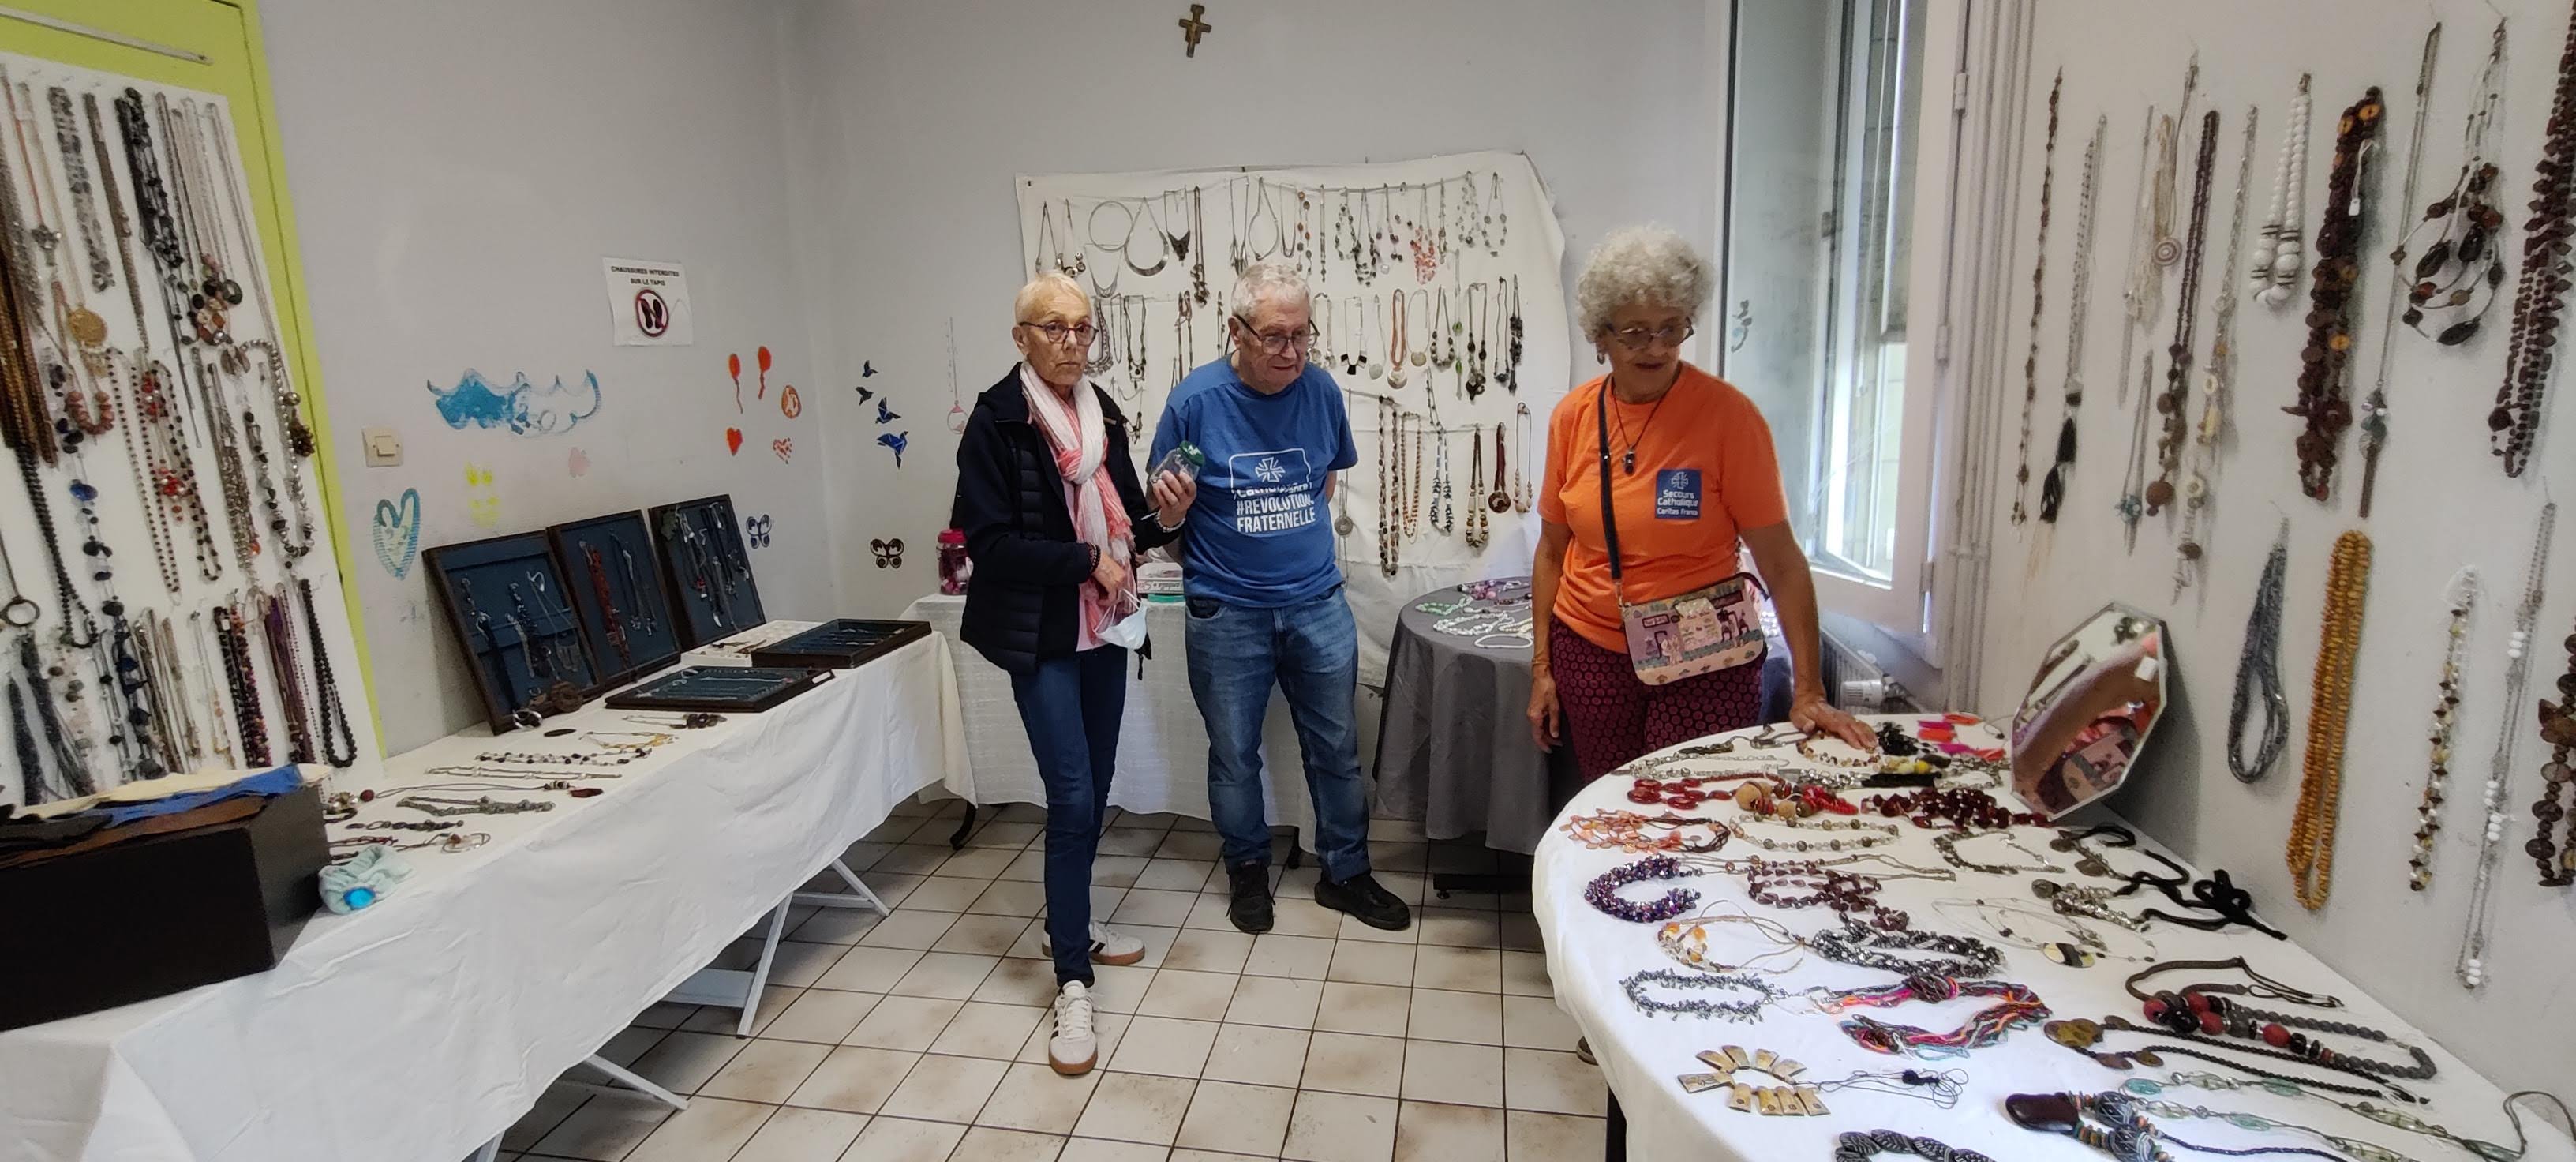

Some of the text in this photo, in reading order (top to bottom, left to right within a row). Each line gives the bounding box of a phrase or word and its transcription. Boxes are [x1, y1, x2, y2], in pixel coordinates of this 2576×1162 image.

[1663, 489, 1694, 499] Secours
[1657, 497, 1698, 508] Catholique
[1237, 507, 1316, 533] FRATERNELLE
